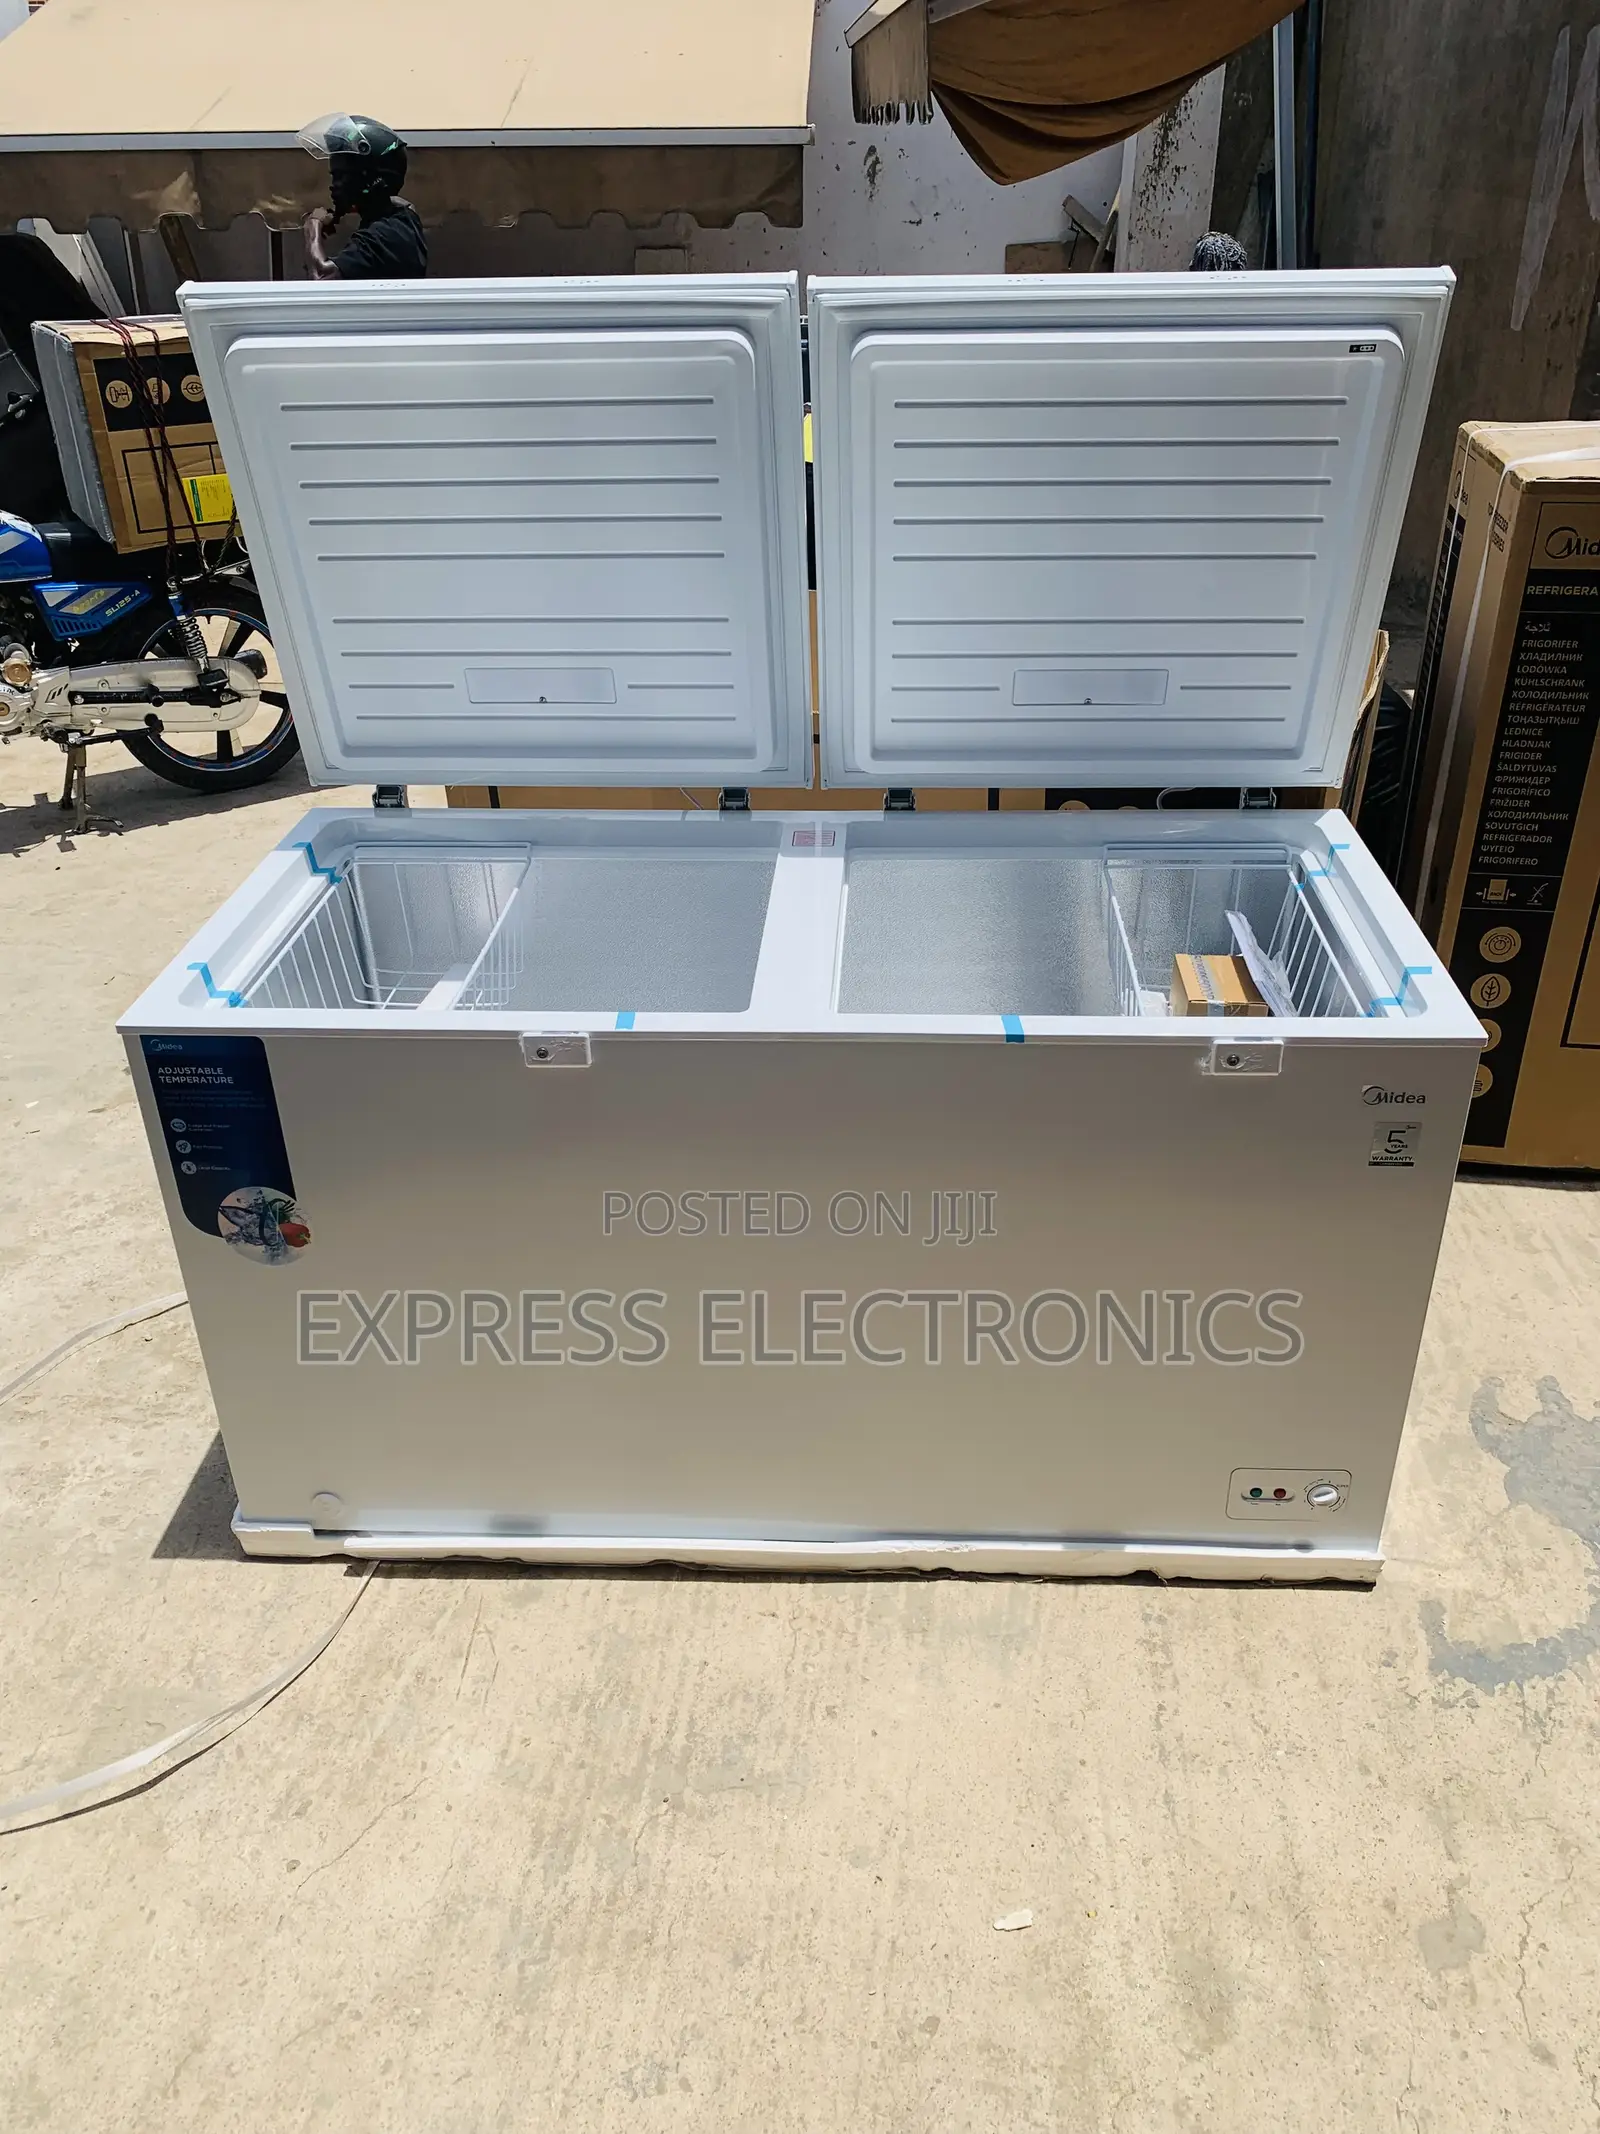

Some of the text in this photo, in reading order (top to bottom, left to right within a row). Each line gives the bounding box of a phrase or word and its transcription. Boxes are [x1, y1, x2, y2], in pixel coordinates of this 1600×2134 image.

[1526, 585, 1599, 596] REFRIGERA
[1522, 640, 1579, 649] FRIGORIFER
[1519, 652, 1583, 662] ХЛАДИЛНИК
[1512, 690, 1590, 700] ХОЛОДИЛЬНИК
[1504, 728, 1544, 736] LEDNICE
[1501, 740, 1551, 749] HLADNJAK
[1499, 752, 1543, 760] FRIGIDER
[1494, 775, 1551, 786] ФРИЖИДЕР
[1485, 822, 1539, 832] SOVUTGICH
[1482, 833, 1553, 843] REFRIGERADOR
[1478, 856, 1539, 866] FRIGORIFERO
[150, 1039, 183, 1052] Midea
[157, 1067, 224, 1075] ADJUSTABLE
[158, 1076, 234, 1084] TEMPERATURE
[1362, 1085, 1426, 1106] Midea
